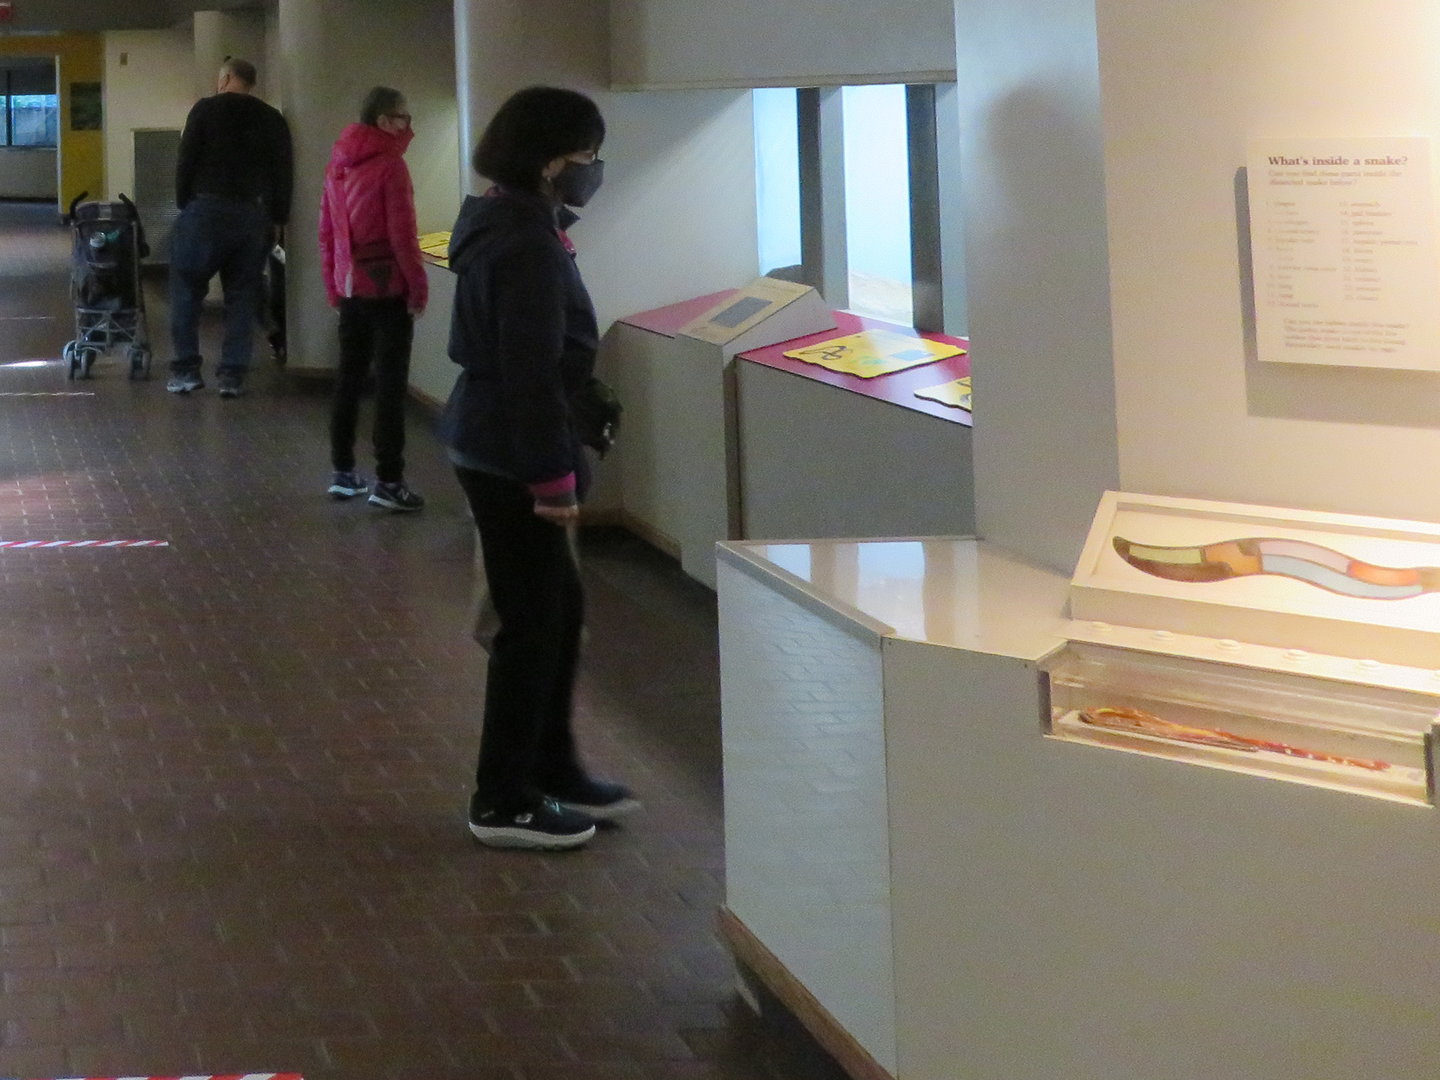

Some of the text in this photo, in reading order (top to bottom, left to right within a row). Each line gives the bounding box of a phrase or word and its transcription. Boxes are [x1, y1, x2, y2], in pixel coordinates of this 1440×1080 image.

[1268, 155, 1409, 166] What's inside a snake?
